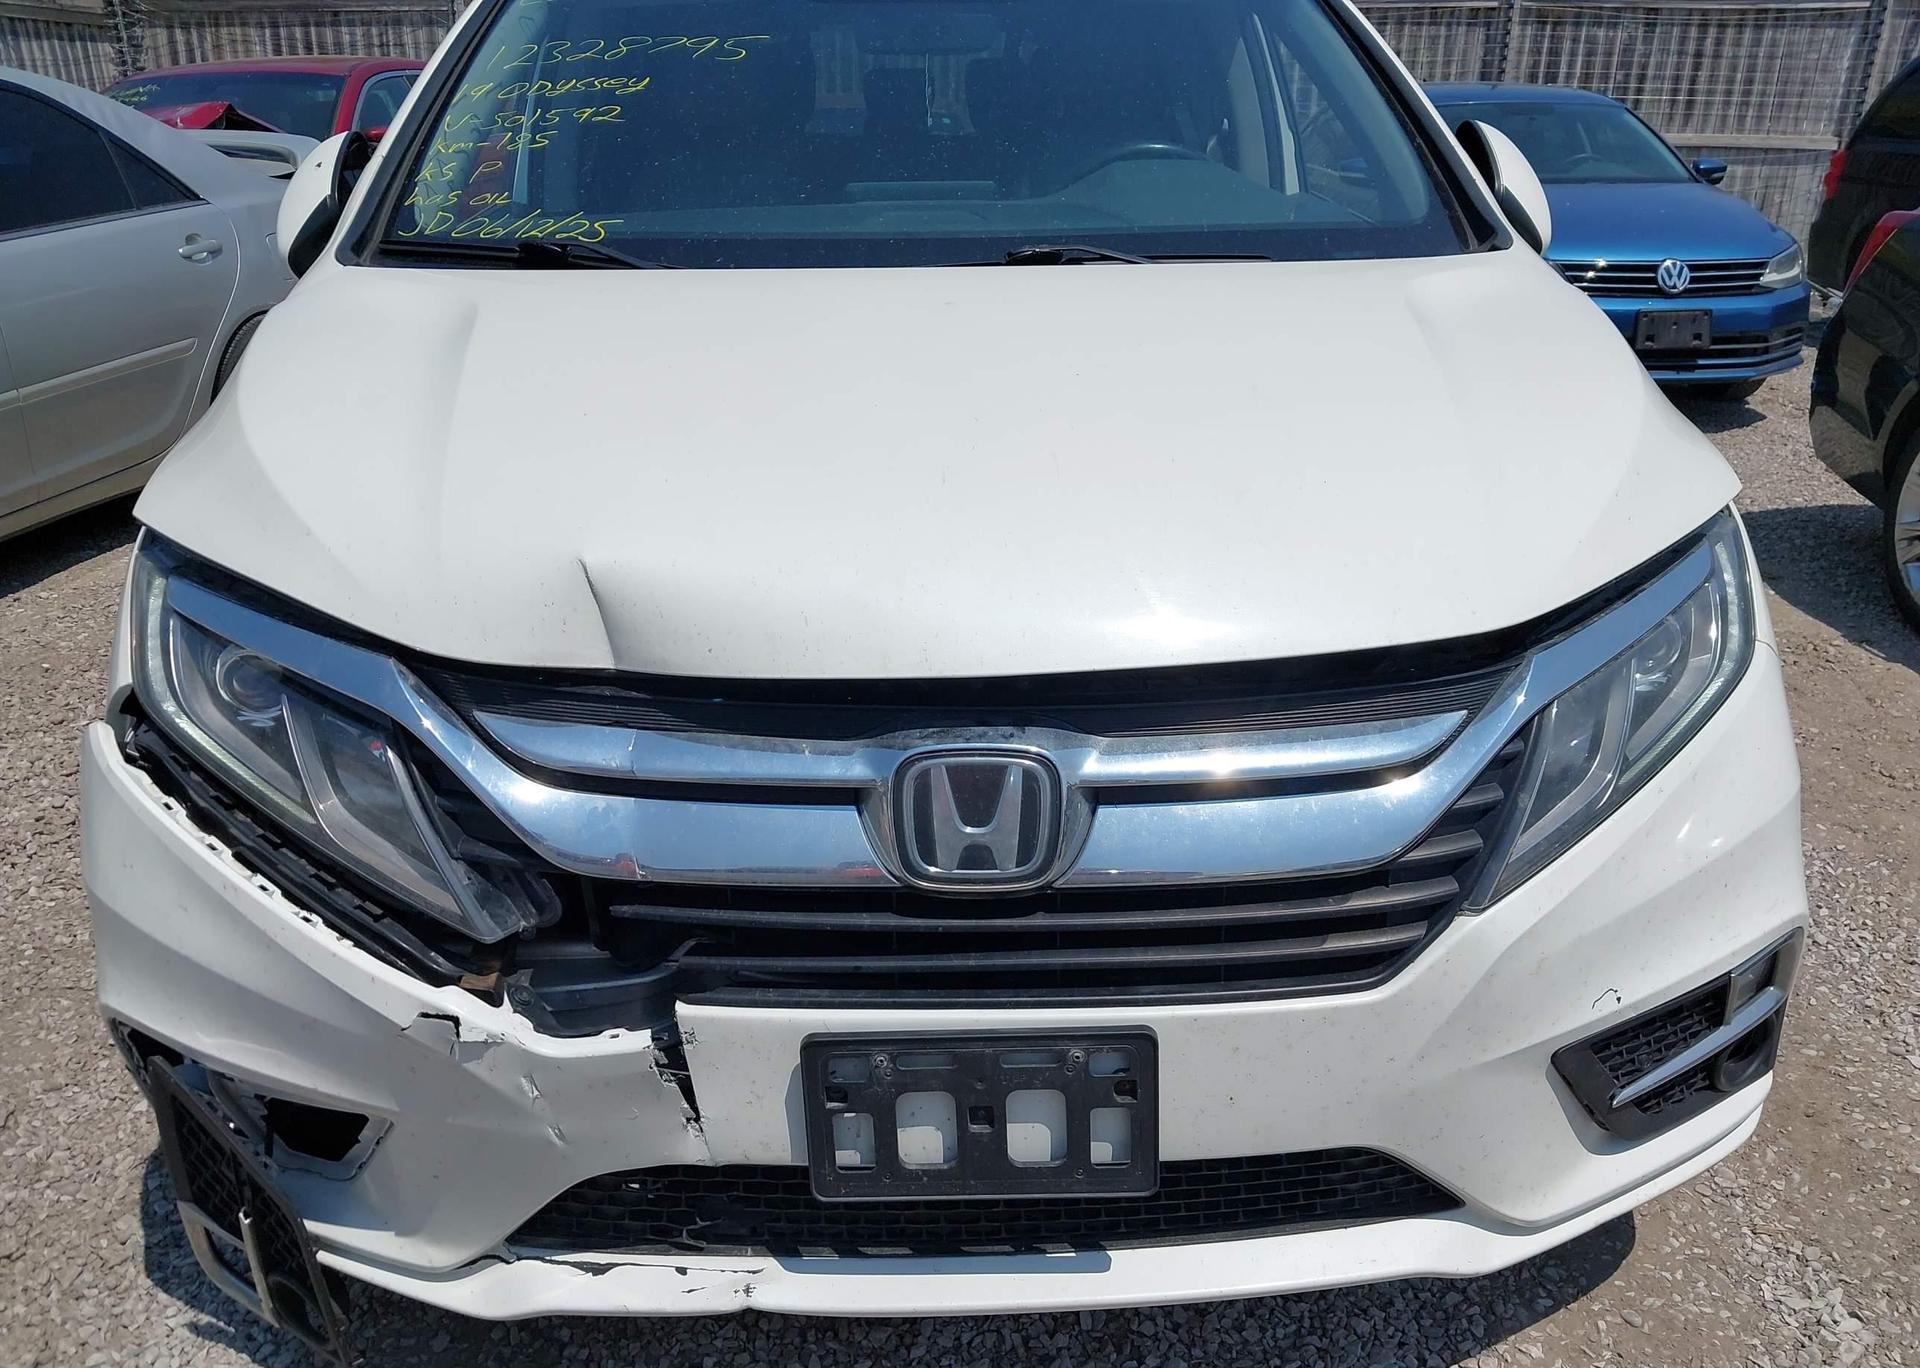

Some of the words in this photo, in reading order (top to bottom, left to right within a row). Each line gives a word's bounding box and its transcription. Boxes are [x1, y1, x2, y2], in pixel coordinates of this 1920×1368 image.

[486, 35, 770, 70] 12328795
[452, 80, 493, 104] 19
[469, 161, 502, 184] P
[451, 208, 624, 242] 06/12/25
